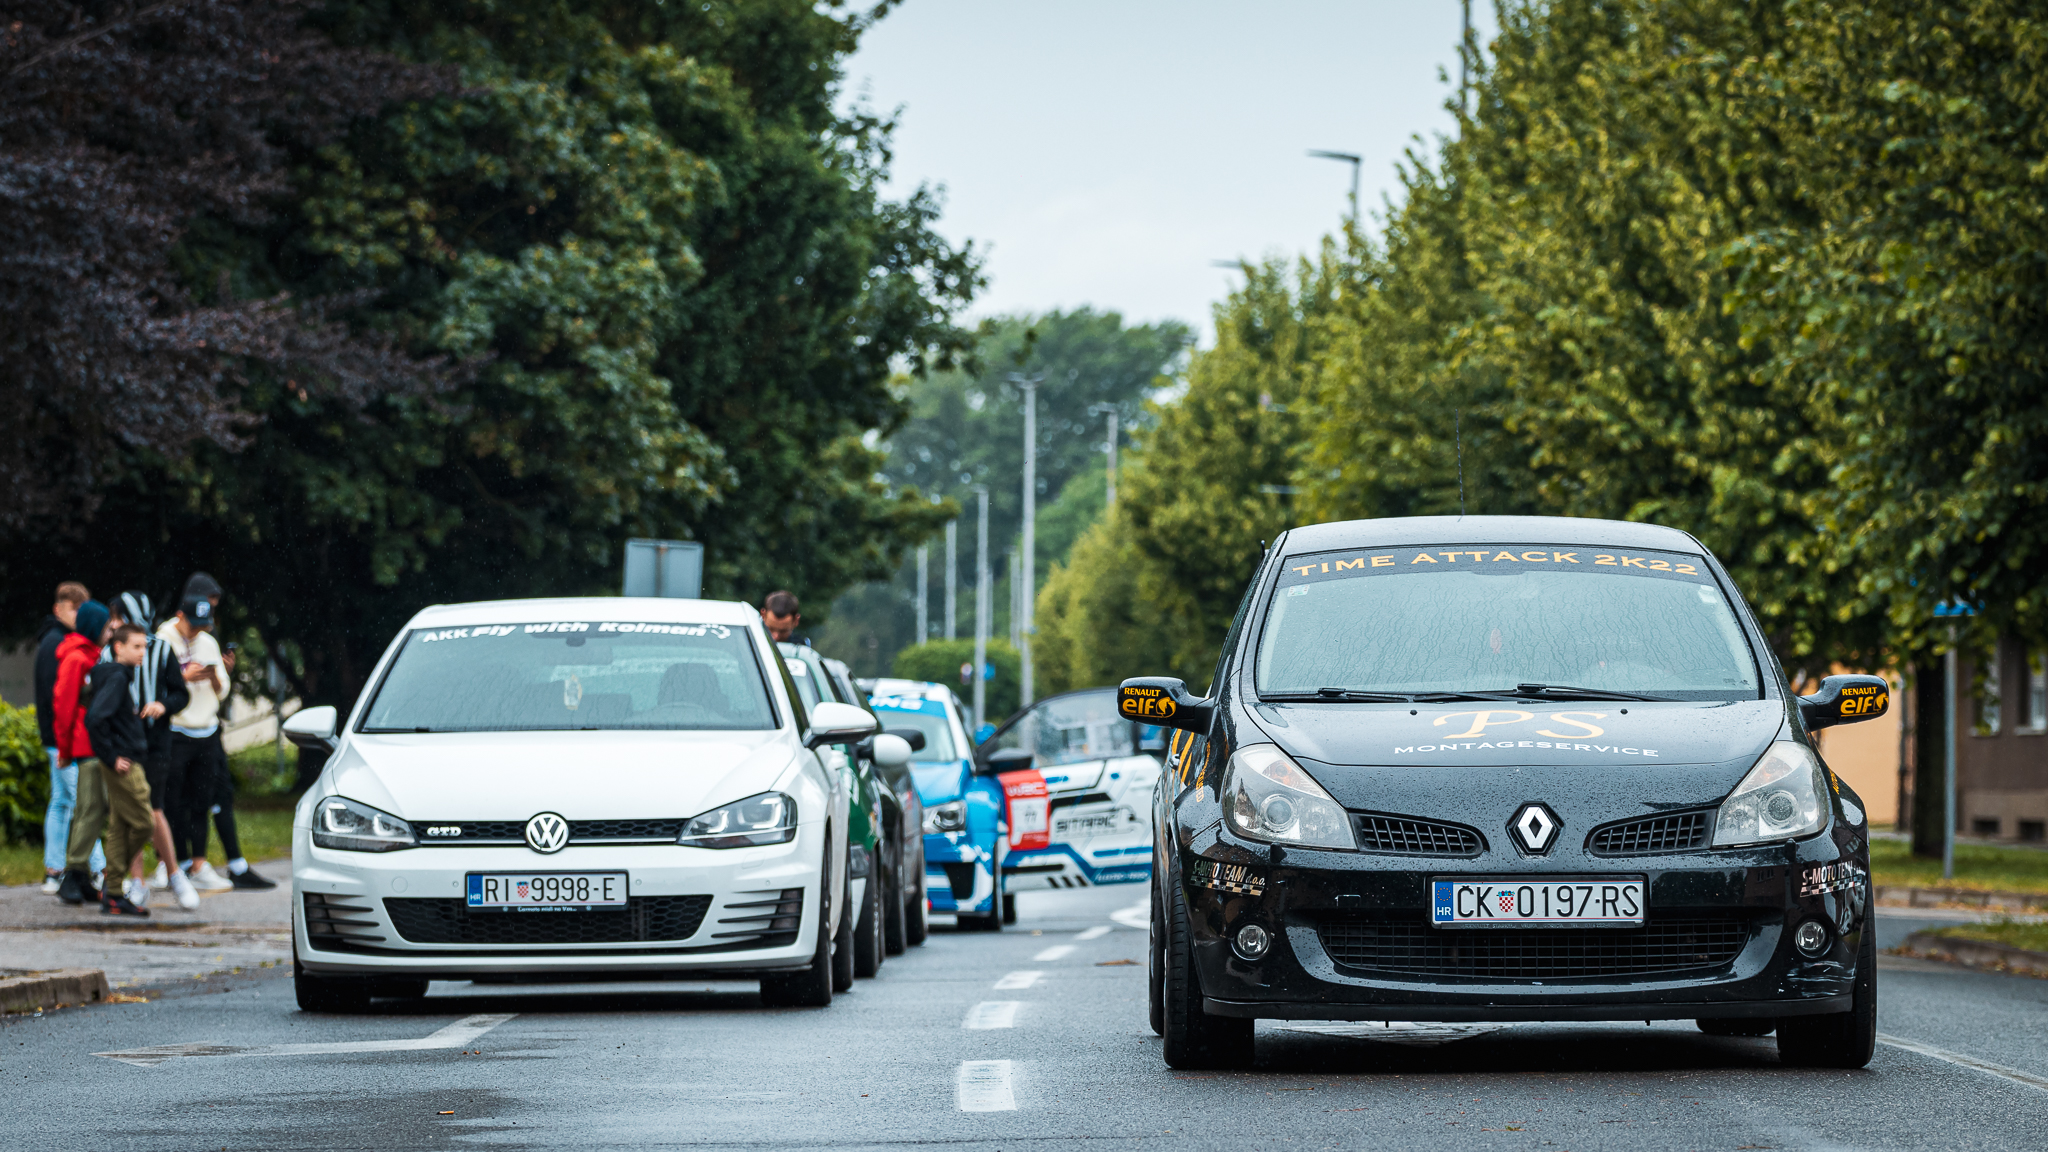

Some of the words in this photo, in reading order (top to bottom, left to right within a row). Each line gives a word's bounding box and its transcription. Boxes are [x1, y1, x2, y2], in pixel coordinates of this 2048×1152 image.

[1292, 555, 1396, 577] TIME
[1410, 551, 1581, 565] ATTACK
[1594, 554, 1699, 576] 2K22
[422, 628, 469, 642] AKK
[471, 625, 517, 637] Fly
[524, 621, 590, 634] with
[598, 622, 708, 637] Kolman
[1124, 687, 1161, 697] RENAULT
[1841, 686, 1878, 696] RENAULT
[1122, 697, 1156, 715] elf
[1840, 695, 1874, 714] elf
[1432, 709, 1608, 739] PS
[1394, 740, 1660, 757] MONTAGESERVICE
[426, 826, 462, 837] GTD
[1192, 860, 1220, 879] S-MOTO
[1220, 864, 1248, 883] TEAM
[1245, 873, 1266, 886] d.o.o.
[1802, 864, 1837, 886] S-MOTO
[485, 878, 509, 902] RI
[531, 877, 615, 902] 9998-E
[1436, 907, 1452, 915] HR
[1457, 885, 1495, 918] ČK
[1517, 885, 1639, 917] 0197-RS
